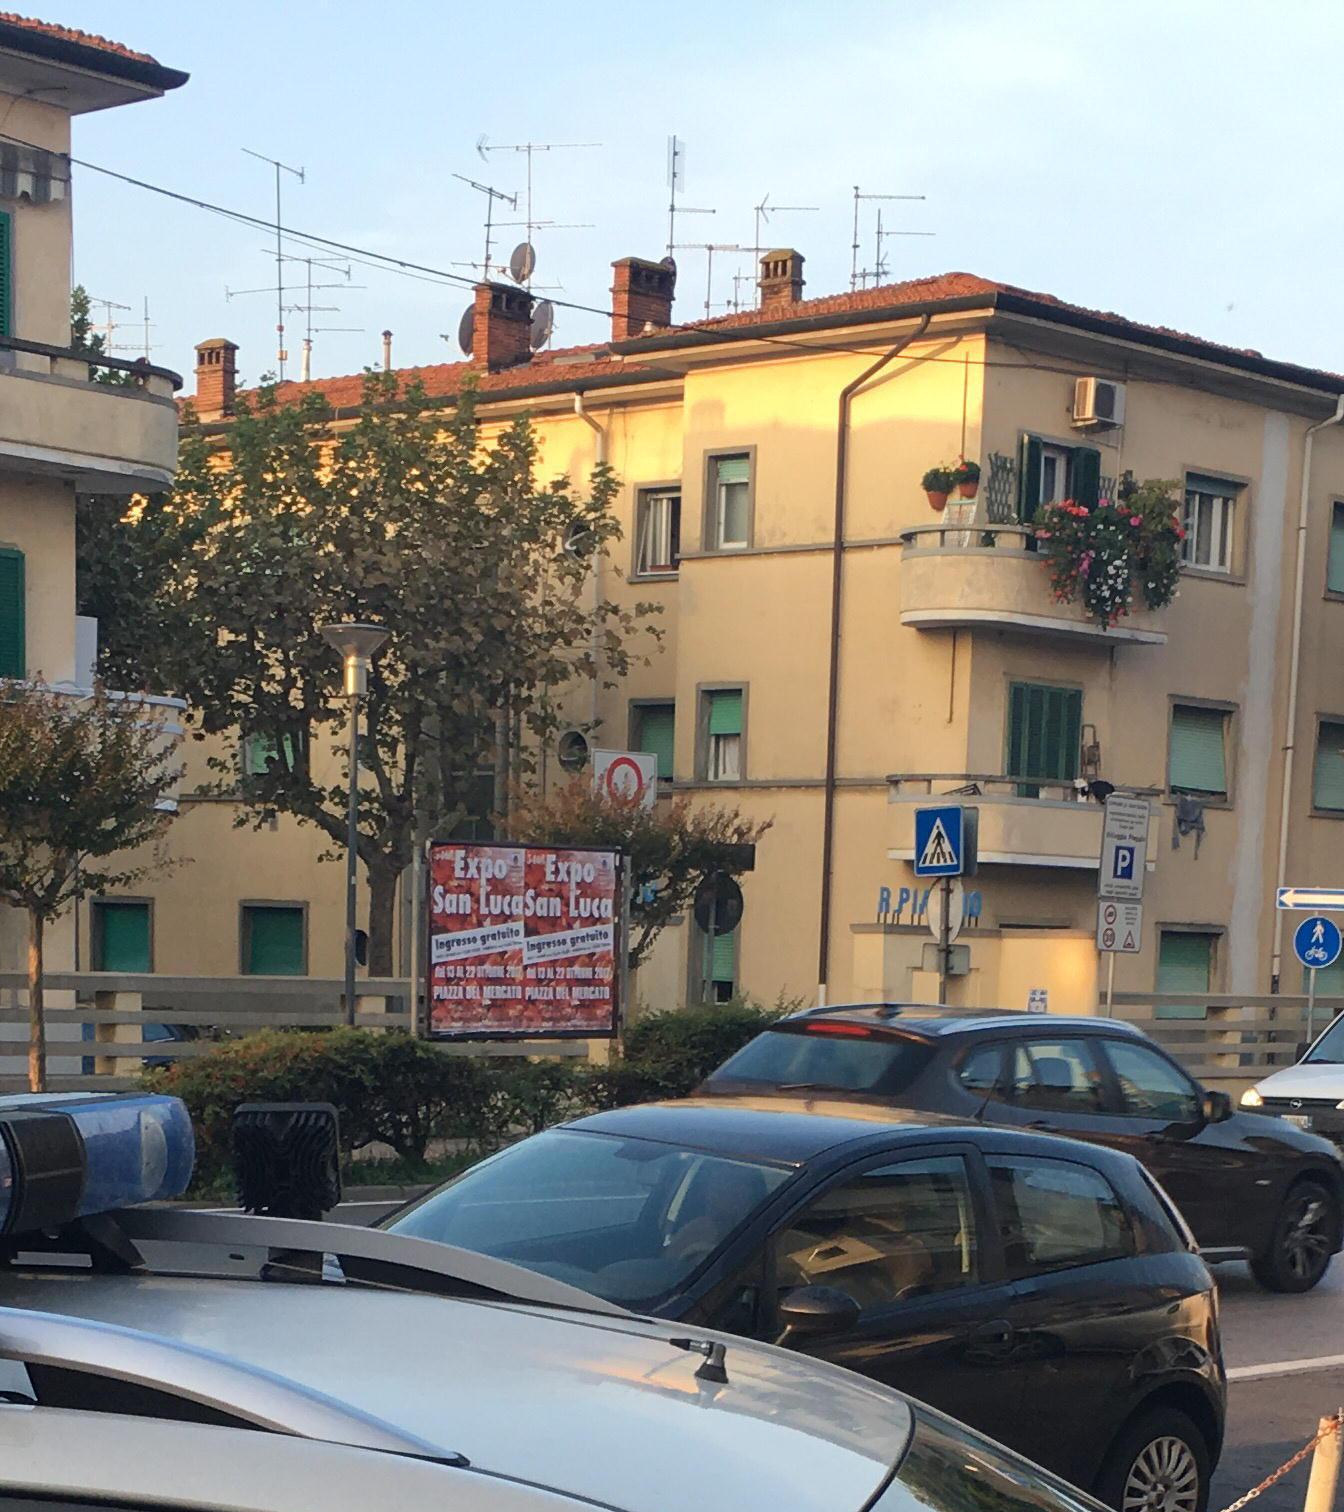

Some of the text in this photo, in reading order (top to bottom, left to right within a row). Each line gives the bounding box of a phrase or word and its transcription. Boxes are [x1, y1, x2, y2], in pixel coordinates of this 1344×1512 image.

[454, 849, 508, 886] Expo
[545, 854, 595, 890] Expo
[1117, 849, 1131, 876] P
[433, 885, 524, 915] San Luca
[525, 889, 613, 918] San Luca
[435, 936, 477, 952] Ingresso
[480, 926, 520, 945] gratuito
[526, 938, 567, 953] Ingresso
[570, 929, 609, 947] gratuito
[433, 985, 463, 999] PIAZZA
[483, 986, 522, 999] MERCATO
[525, 986, 553, 1000] PIAZZA
[572, 987, 610, 999] MERCATO
